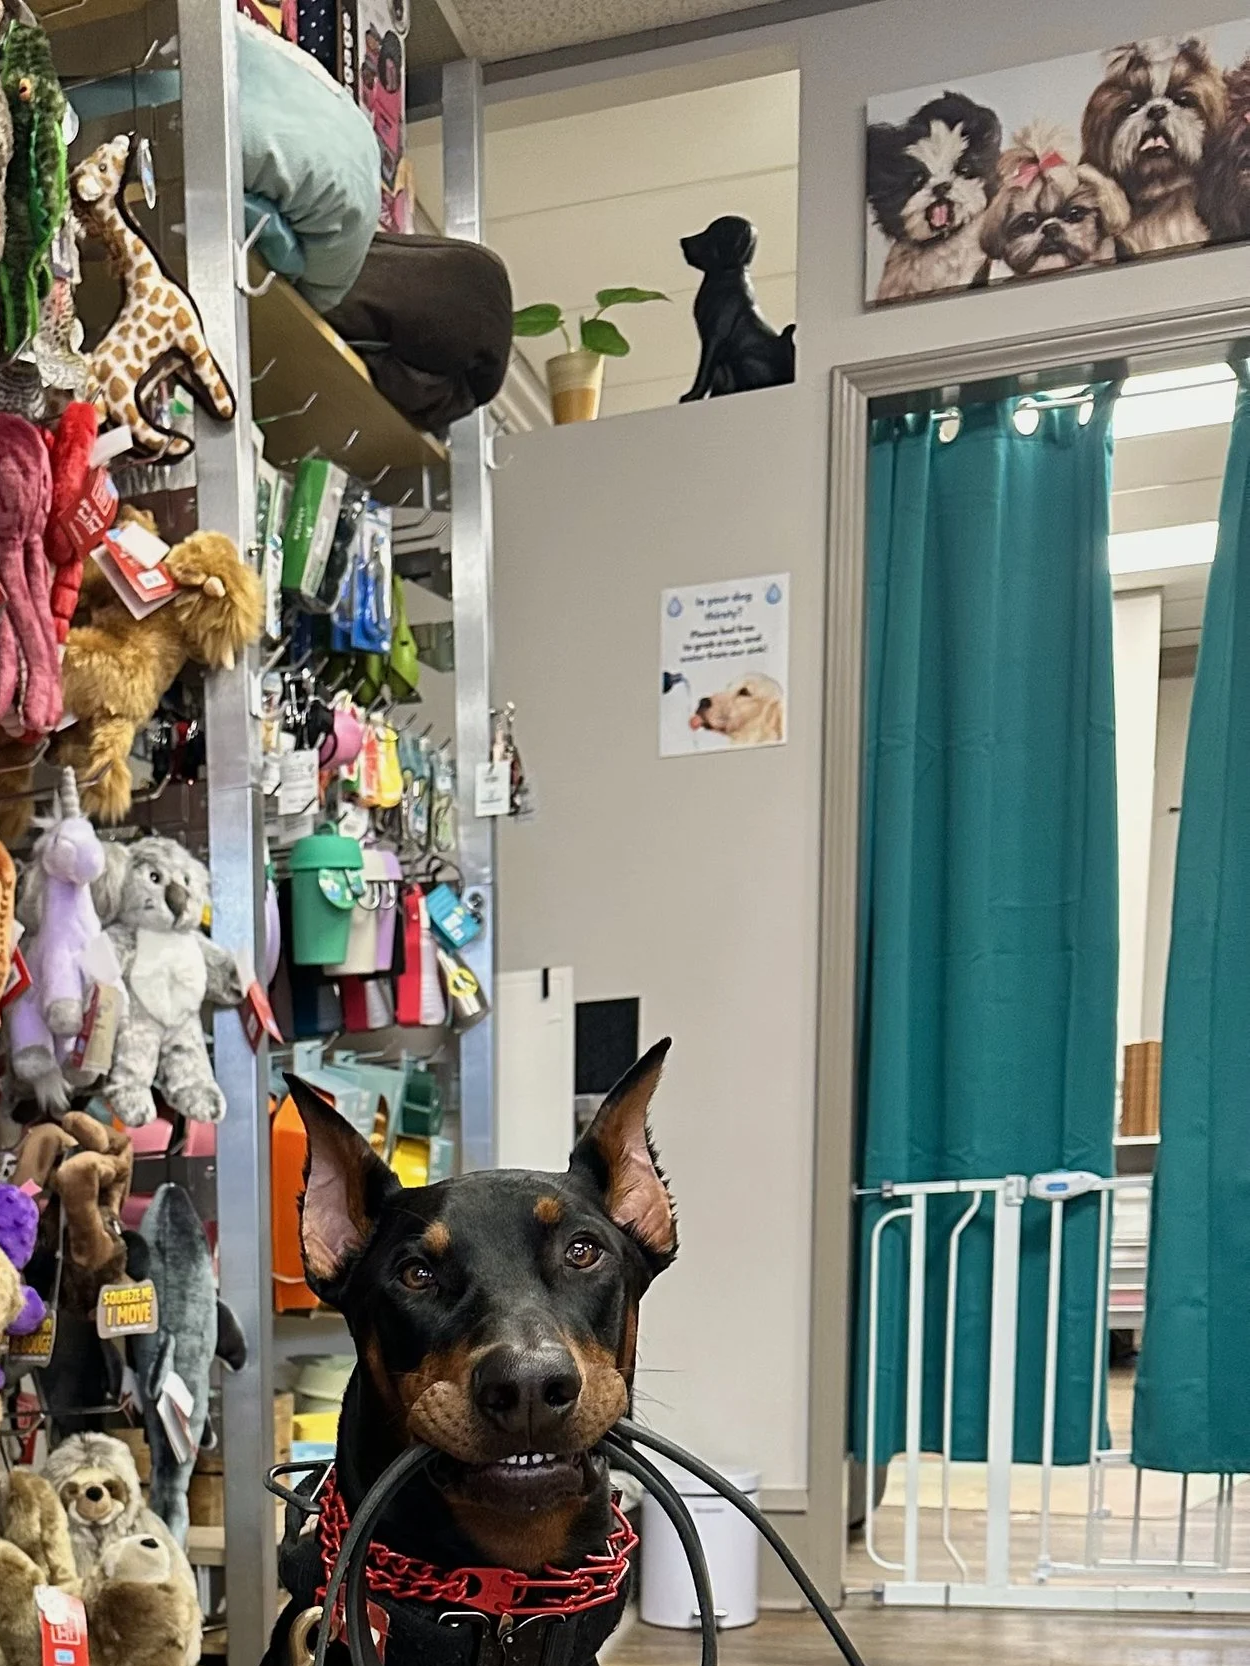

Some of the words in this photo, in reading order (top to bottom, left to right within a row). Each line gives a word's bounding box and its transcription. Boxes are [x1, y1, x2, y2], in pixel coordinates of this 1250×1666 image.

[103, 1288, 141, 1305] SQUEEZE
[142, 1287, 152, 1301] ME
[107, 1307, 112, 1326] I
[117, 1303, 152, 1326] MOVE
